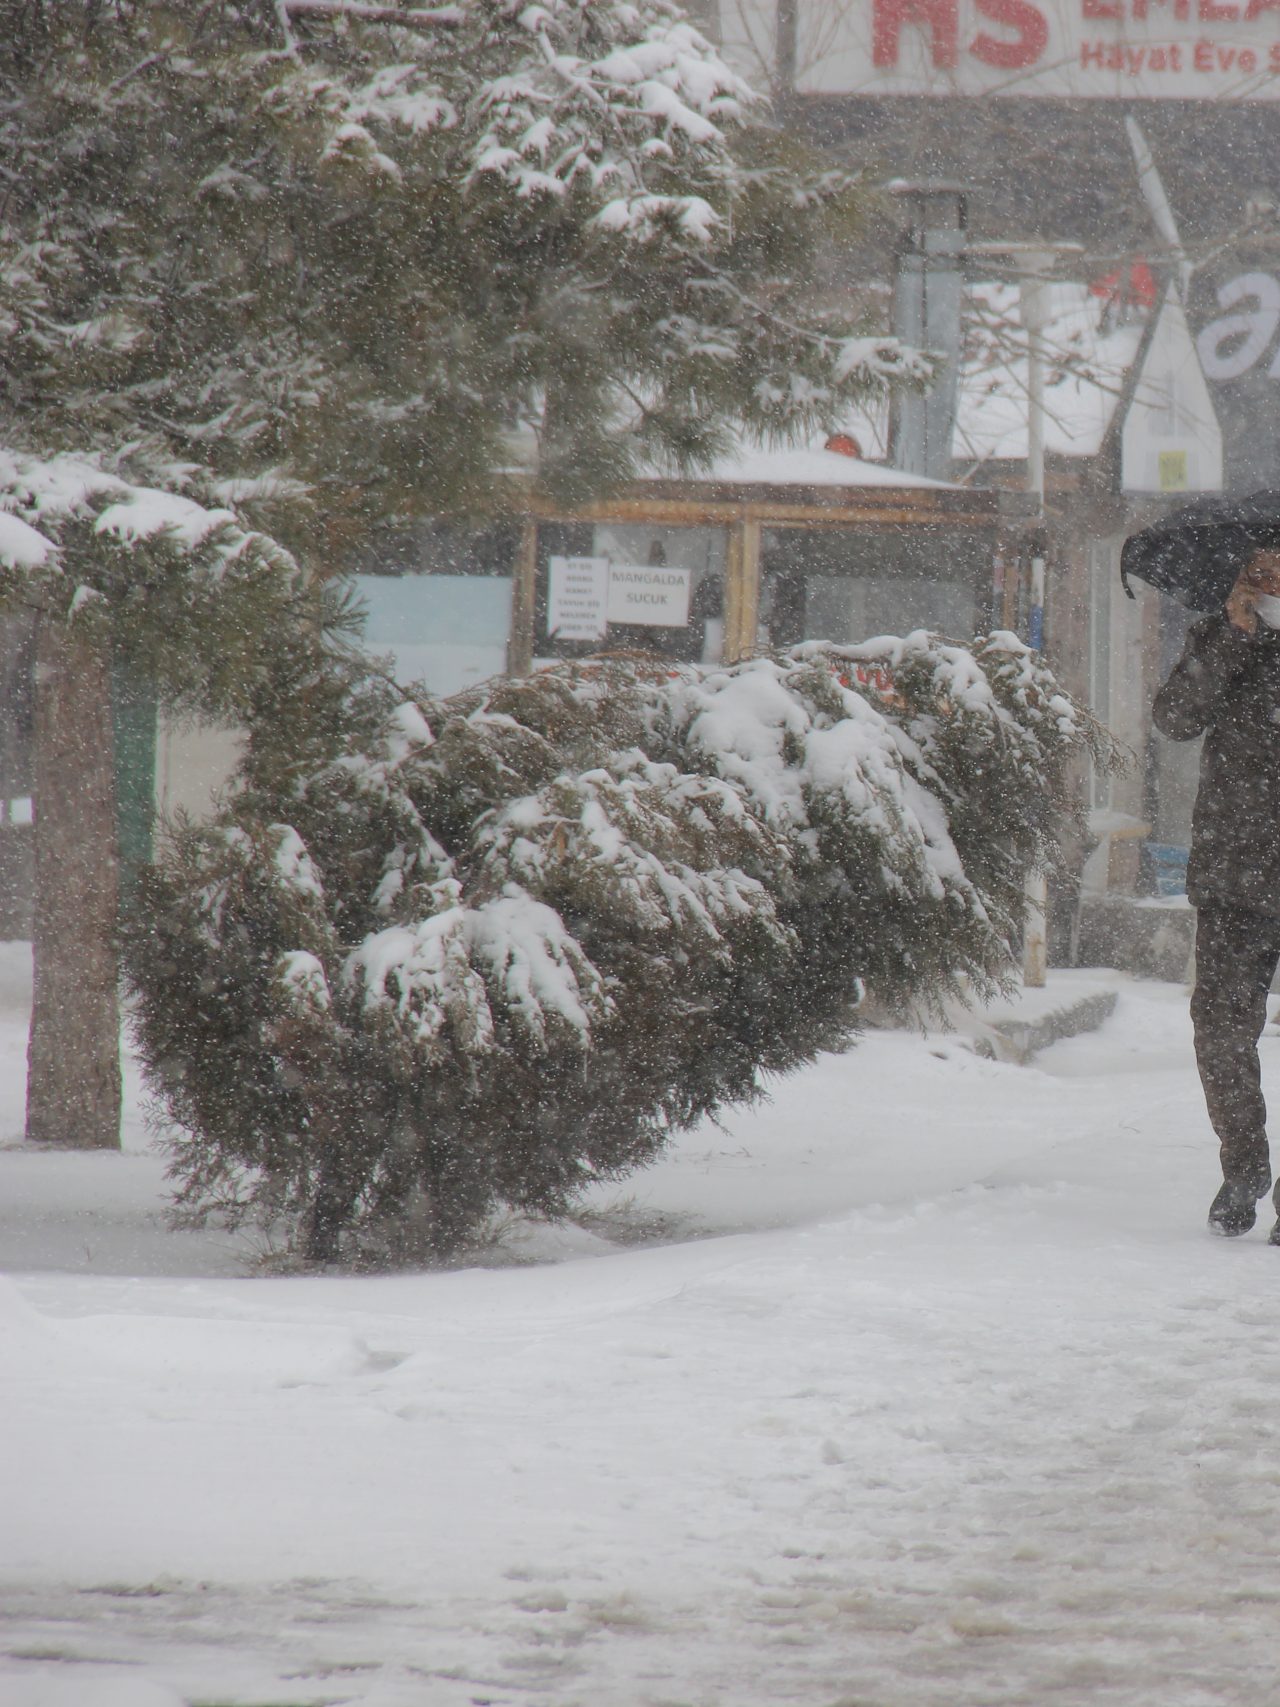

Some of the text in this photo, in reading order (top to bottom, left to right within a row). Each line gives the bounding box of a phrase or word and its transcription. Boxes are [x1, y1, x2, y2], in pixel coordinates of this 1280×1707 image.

[1080, 41, 1182, 77] Hayat
[1193, 40, 1257, 73] Eve
[611, 571, 686, 586] MANGALDA
[625, 592, 669, 606] SUCUK
